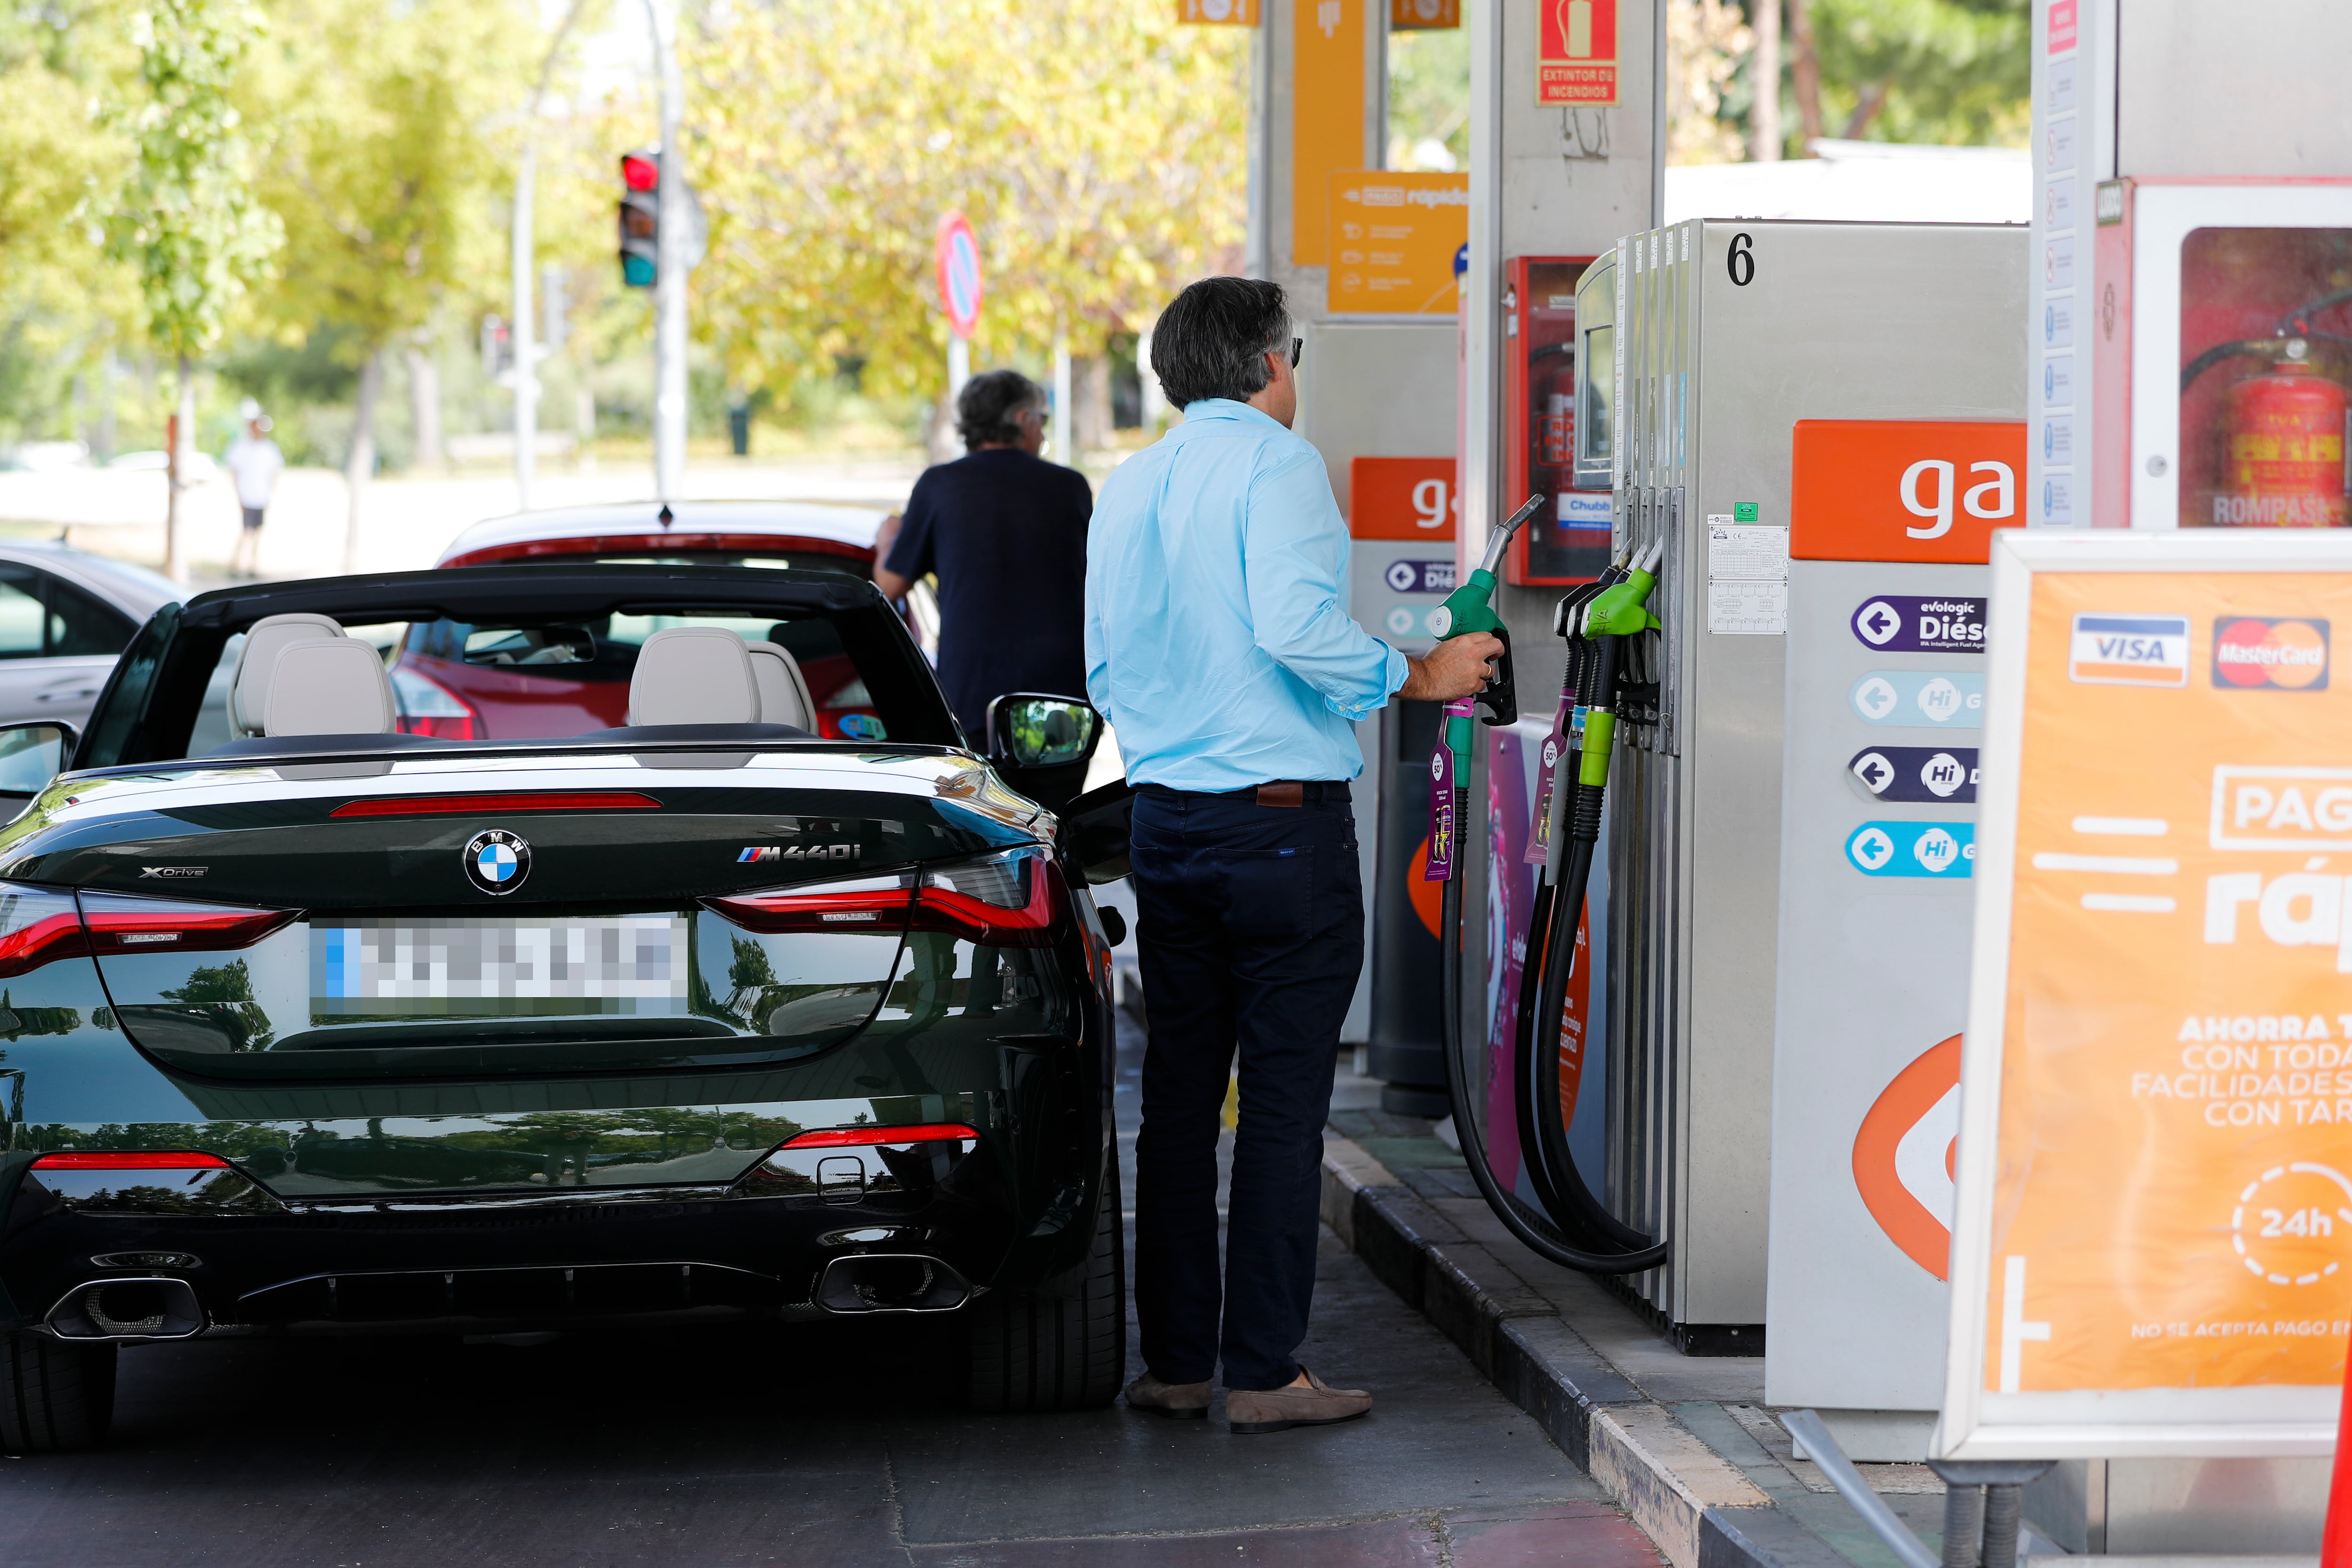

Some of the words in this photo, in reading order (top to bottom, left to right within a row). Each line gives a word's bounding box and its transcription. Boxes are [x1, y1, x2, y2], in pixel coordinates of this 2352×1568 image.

[1543, 70, 1597, 81] EXTINTOR
[1599, 71, 1613, 82] DE
[1548, 86, 1608, 98] INCENDIOS
[1727, 233, 1755, 286] 6
[1412, 478, 1456, 528] g
[1570, 500, 1610, 511] Chubb
[1899, 459, 2016, 540] ga
[1920, 601, 1975, 616] evologic
[2094, 637, 2165, 661] VISA
[2217, 643, 2324, 668] MasterCard
[1928, 689, 1952, 707] Hi
[1931, 764, 1955, 781] Hi
[471, 832, 524, 853] BMW
[756, 844, 860, 862] M440i
[1923, 840, 1948, 857] Hi
[2177, 1014, 2330, 1042] AHORRA
[2182, 1044, 2257, 1070] CON
[2131, 1070, 2352, 1098] FACILIDADES
[2204, 1100, 2280, 1126] CON
[2288, 1098, 2352, 1125] TAR
[2259, 1206, 2333, 1238] 24h
[2131, 1323, 2161, 1338] NO
[2166, 1322, 2189, 1337] SE
[2193, 1321, 2268, 1337] ACEPTA
[2273, 1320, 2328, 1336] PAGO
